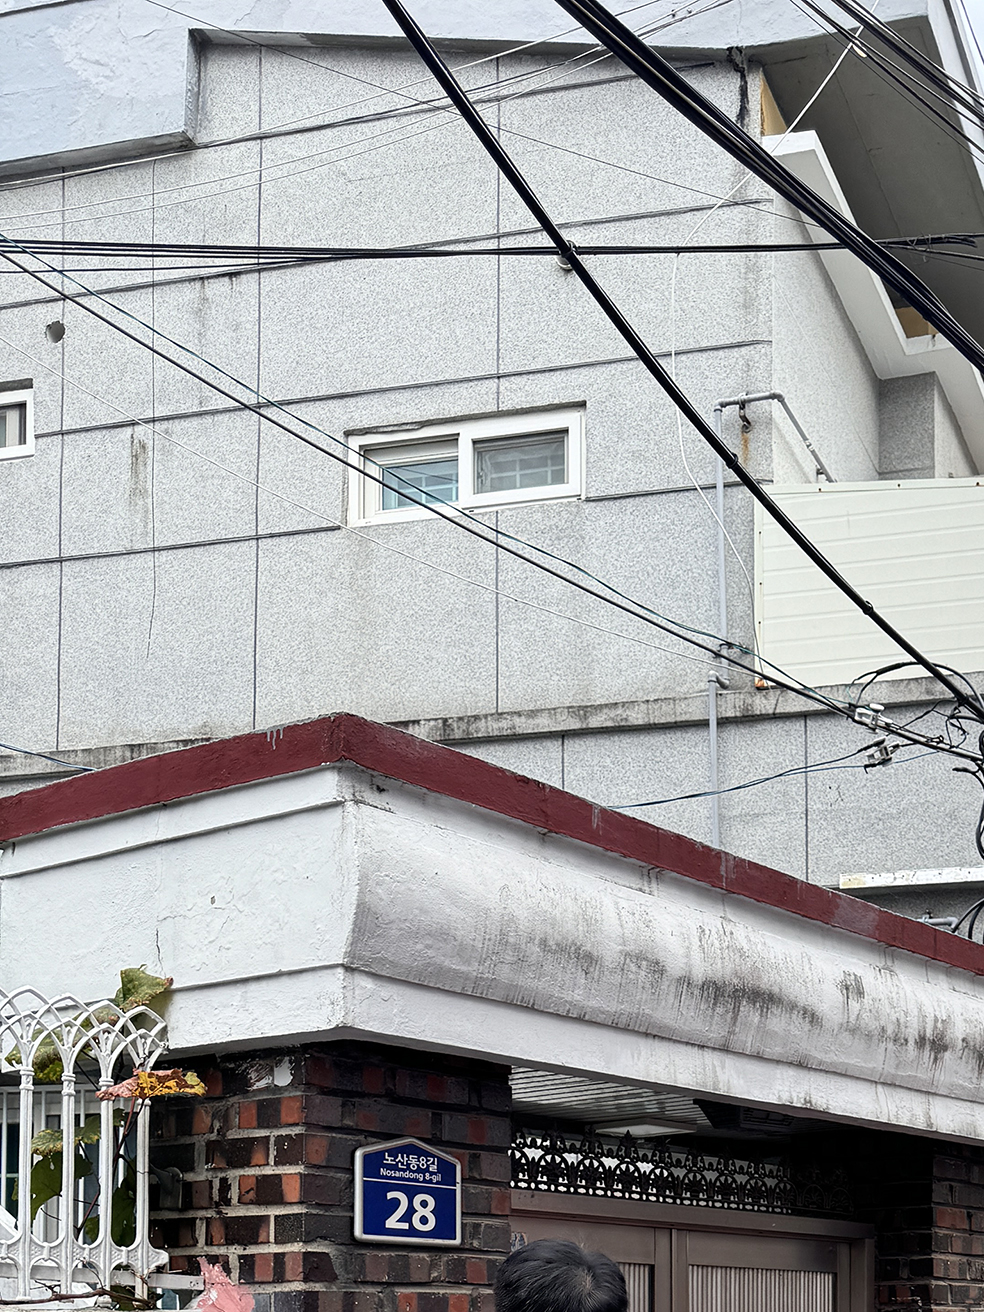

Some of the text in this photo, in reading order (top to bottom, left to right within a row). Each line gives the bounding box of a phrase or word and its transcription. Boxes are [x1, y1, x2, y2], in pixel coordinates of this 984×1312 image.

[383, 1152, 438, 1172] 노산동8길
[380, 1167, 442, 1183] Nosandong 8-gil
[385, 1190, 436, 1232] 28
